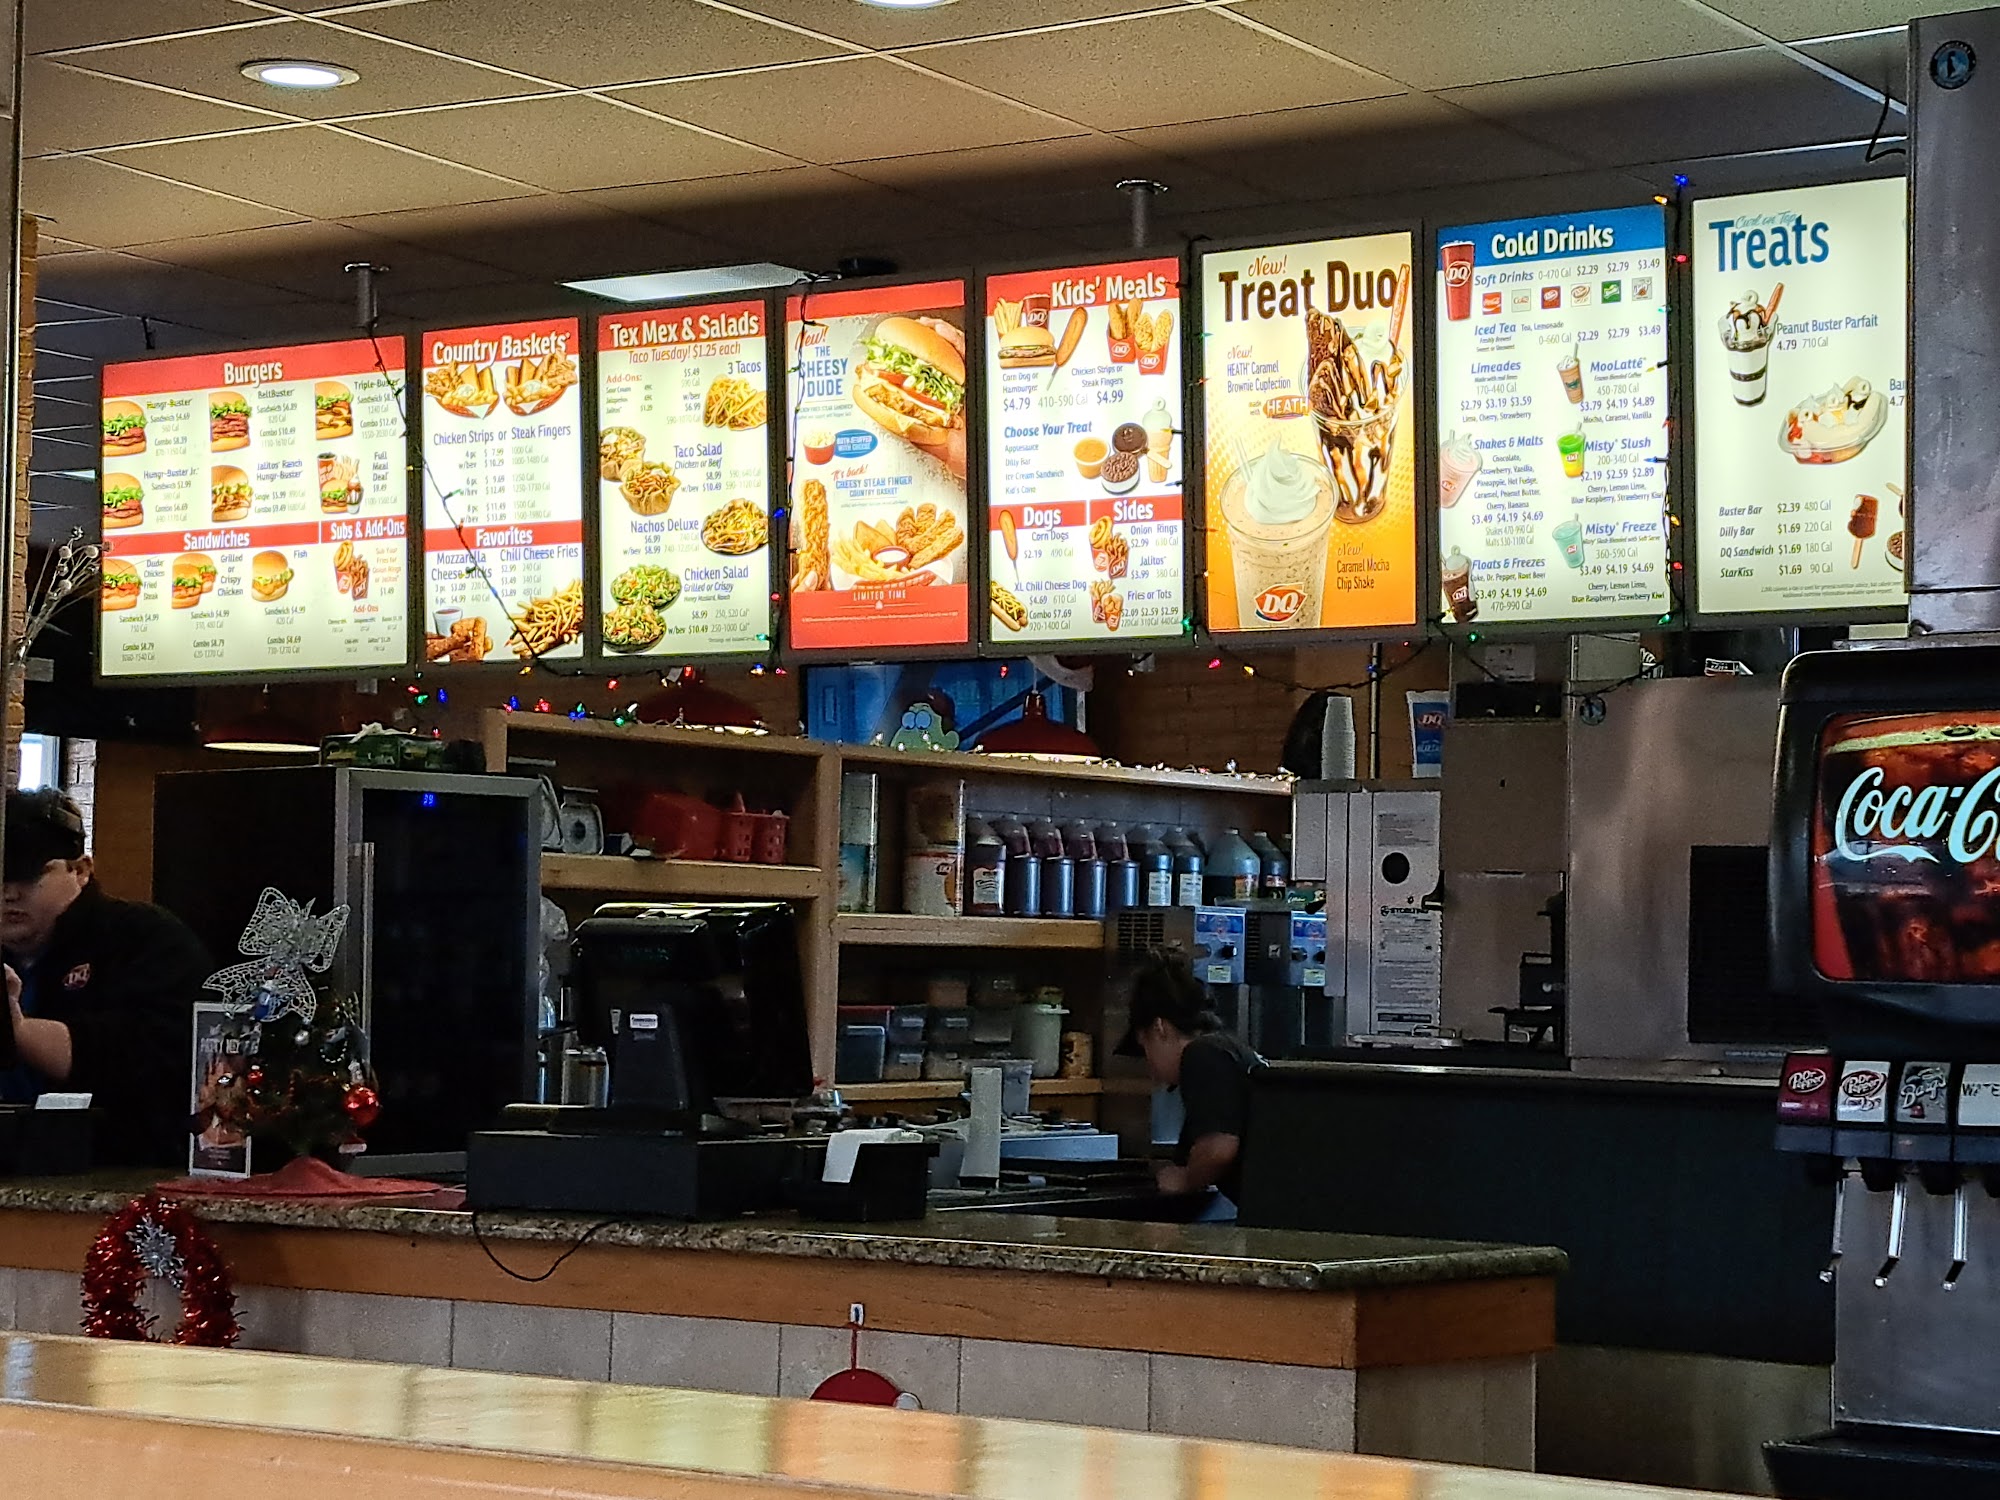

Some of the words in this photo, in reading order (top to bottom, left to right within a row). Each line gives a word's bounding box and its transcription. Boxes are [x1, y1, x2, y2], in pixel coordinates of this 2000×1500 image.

[1492, 231, 1538, 259] Cold
[1544, 225, 1614, 254] Drinks
[1709, 214, 1830, 272] Treats
[1248, 255, 1288, 277] New!
[1450, 266, 1469, 278] DQ
[1475, 274, 1497, 286] Soft
[1500, 271, 1534, 282] Drinks
[1576, 265, 1598, 276] $2.29
[1607, 261, 1629, 273] $2.79
[1638, 258, 1660, 270] $3.49
[1052, 277, 1101, 307] Kids'
[1106, 272, 1166, 301] Meals
[1218, 269, 1314, 322] Treat
[1328, 260, 1398, 312] Duo
[610, 323, 638, 348] Tex
[643, 321, 678, 345] Mex
[681, 316, 695, 341] &
[699, 311, 759, 339] Salads
[1475, 324, 1497, 336] Iced
[1500, 323, 1516, 333] Tea
[1776, 321, 1809, 334] Peanut
[1812, 318, 1841, 333] Buster
[1845, 314, 1878, 328] Parfait
[1577, 331, 1599, 343] $2.29
[1608, 328, 1630, 339] $2.79
[1639, 325, 1661, 337] $3.49
[815, 346, 830, 357] THE
[1776, 339, 1797, 350] 4.79
[433, 339, 498, 366] Country
[628, 350, 648, 364] Taco
[651, 347, 691, 362] Tuesday!
[692, 343, 716, 359] $1.25
[719, 341, 741, 355] each
[1227, 345, 1253, 359] New!
[728, 362, 734, 374] 3
[736, 360, 761, 373] Tacos
[1251, 361, 1279, 375] Caramel
[1471, 360, 1521, 374] Limeades
[224, 361, 283, 388] Burgers
[606, 374, 642, 383] Add-Ons:
[807, 379, 843, 397] DUDE
[1227, 380, 1253, 394] Brownie
[1004, 398, 1031, 412] $4.79
[1096, 389, 1124, 405] $4.99
[1266, 398, 1309, 414] HEATH
[1461, 400, 1482, 411] $2.79
[1485, 398, 1507, 409] $3.19
[1510, 397, 1532, 407] $3.59
[1580, 401, 1601, 412] $3.79
[1606, 398, 1628, 410] $4.19
[1632, 397, 1655, 408] $4.89
[434, 433, 467, 445] Chicken
[468, 430, 494, 444] Strips
[498, 430, 507, 439] or
[511, 427, 535, 439] Steak
[538, 424, 571, 438] Fingers
[1004, 426, 1039, 438] Choose
[1042, 424, 1064, 435] Your
[1068, 421, 1092, 433] Treat
[1475, 439, 1507, 450] Shakes
[1509, 437, 1515, 447] &
[1517, 435, 1544, 447] Malts
[1621, 438, 1651, 449] Slush
[674, 445, 694, 458] Taco
[697, 442, 722, 456] Salad
[1606, 468, 1628, 480] $2.59
[1632, 467, 1654, 478] $2.89
[702, 482, 721, 492] $10.49
[1114, 500, 1153, 521] Sides
[1719, 507, 1746, 516] Buster
[1748, 505, 1763, 515] Bar
[1777, 501, 1800, 514] $2.39
[630, 520, 665, 533] Nachos
[667, 518, 699, 531] Deluxe
[1024, 507, 1062, 531] Dogs
[331, 522, 352, 540] Subs
[355, 521, 362, 538] &
[365, 519, 404, 537] Add-Ons
[1130, 526, 1153, 535] Onion
[1157, 524, 1178, 535] Rings
[1622, 521, 1657, 532] Freeze
[1720, 528, 1739, 538] Dilly
[1740, 527, 1755, 536] Bar
[1777, 522, 1800, 534] $1.69
[184, 530, 250, 550] Sandwiches
[476, 526, 533, 547] Favorites
[1032, 532, 1049, 542] Corn
[1051, 530, 1069, 542] Dogs
[1131, 537, 1149, 548] $2.99
[294, 550, 307, 558] Fish
[500, 549, 521, 561] Chili
[523, 548, 555, 561] Cheese
[557, 545, 578, 559] Fries
[1024, 550, 1042, 559] $2.19
[1338, 542, 1364, 556] New!
[1720, 548, 1732, 558] DQ
[1733, 545, 1774, 557] Sandwich
[1778, 544, 1801, 555] $1.69
[221, 554, 243, 563] Grilled
[1140, 556, 1164, 567] Jalitos
[1337, 560, 1365, 572] Caramel
[1367, 557, 1390, 571] Mocha
[1472, 558, 1501, 570] Floats
[1503, 557, 1510, 568] &
[1512, 556, 1546, 568] Freezes
[431, 568, 462, 580] Cheese
[684, 568, 720, 582] Chicken
[723, 566, 748, 579] Salad
[1131, 569, 1149, 580] $3.99
[1720, 567, 1753, 578] StarKiss
[1779, 565, 1802, 576] $1.69
[220, 576, 241, 584] Crispy
[1014, 583, 1024, 592] XL
[1026, 582, 1043, 592] Chili
[1044, 581, 1071, 590] Cheese
[1072, 580, 1087, 591] Dog
[1337, 576, 1351, 592] Chip
[1354, 577, 1374, 589] Shake
[218, 588, 243, 596] Chicken
[853, 590, 884, 601] LIMITED
[888, 590, 906, 599] TIME
[1127, 590, 1145, 600] Fries
[1147, 591, 1155, 599] or
[1156, 589, 1172, 599] Tots
[1029, 595, 1048, 605] $4.69
[1263, 593, 1298, 613] DQ
[692, 610, 708, 619] $8.99
[1029, 609, 1052, 619] Combo
[1053, 609, 1072, 618] $7.69
[688, 623, 708, 634] $10.49
[1835, 765, 2000, 863] Coca-C
[1791, 1073, 1824, 1090] Pepper
[1803, 1070, 1816, 1080] Dr
[1858, 1075, 1871, 1084] Dr
[1847, 1079, 1880, 1093] Pepper
